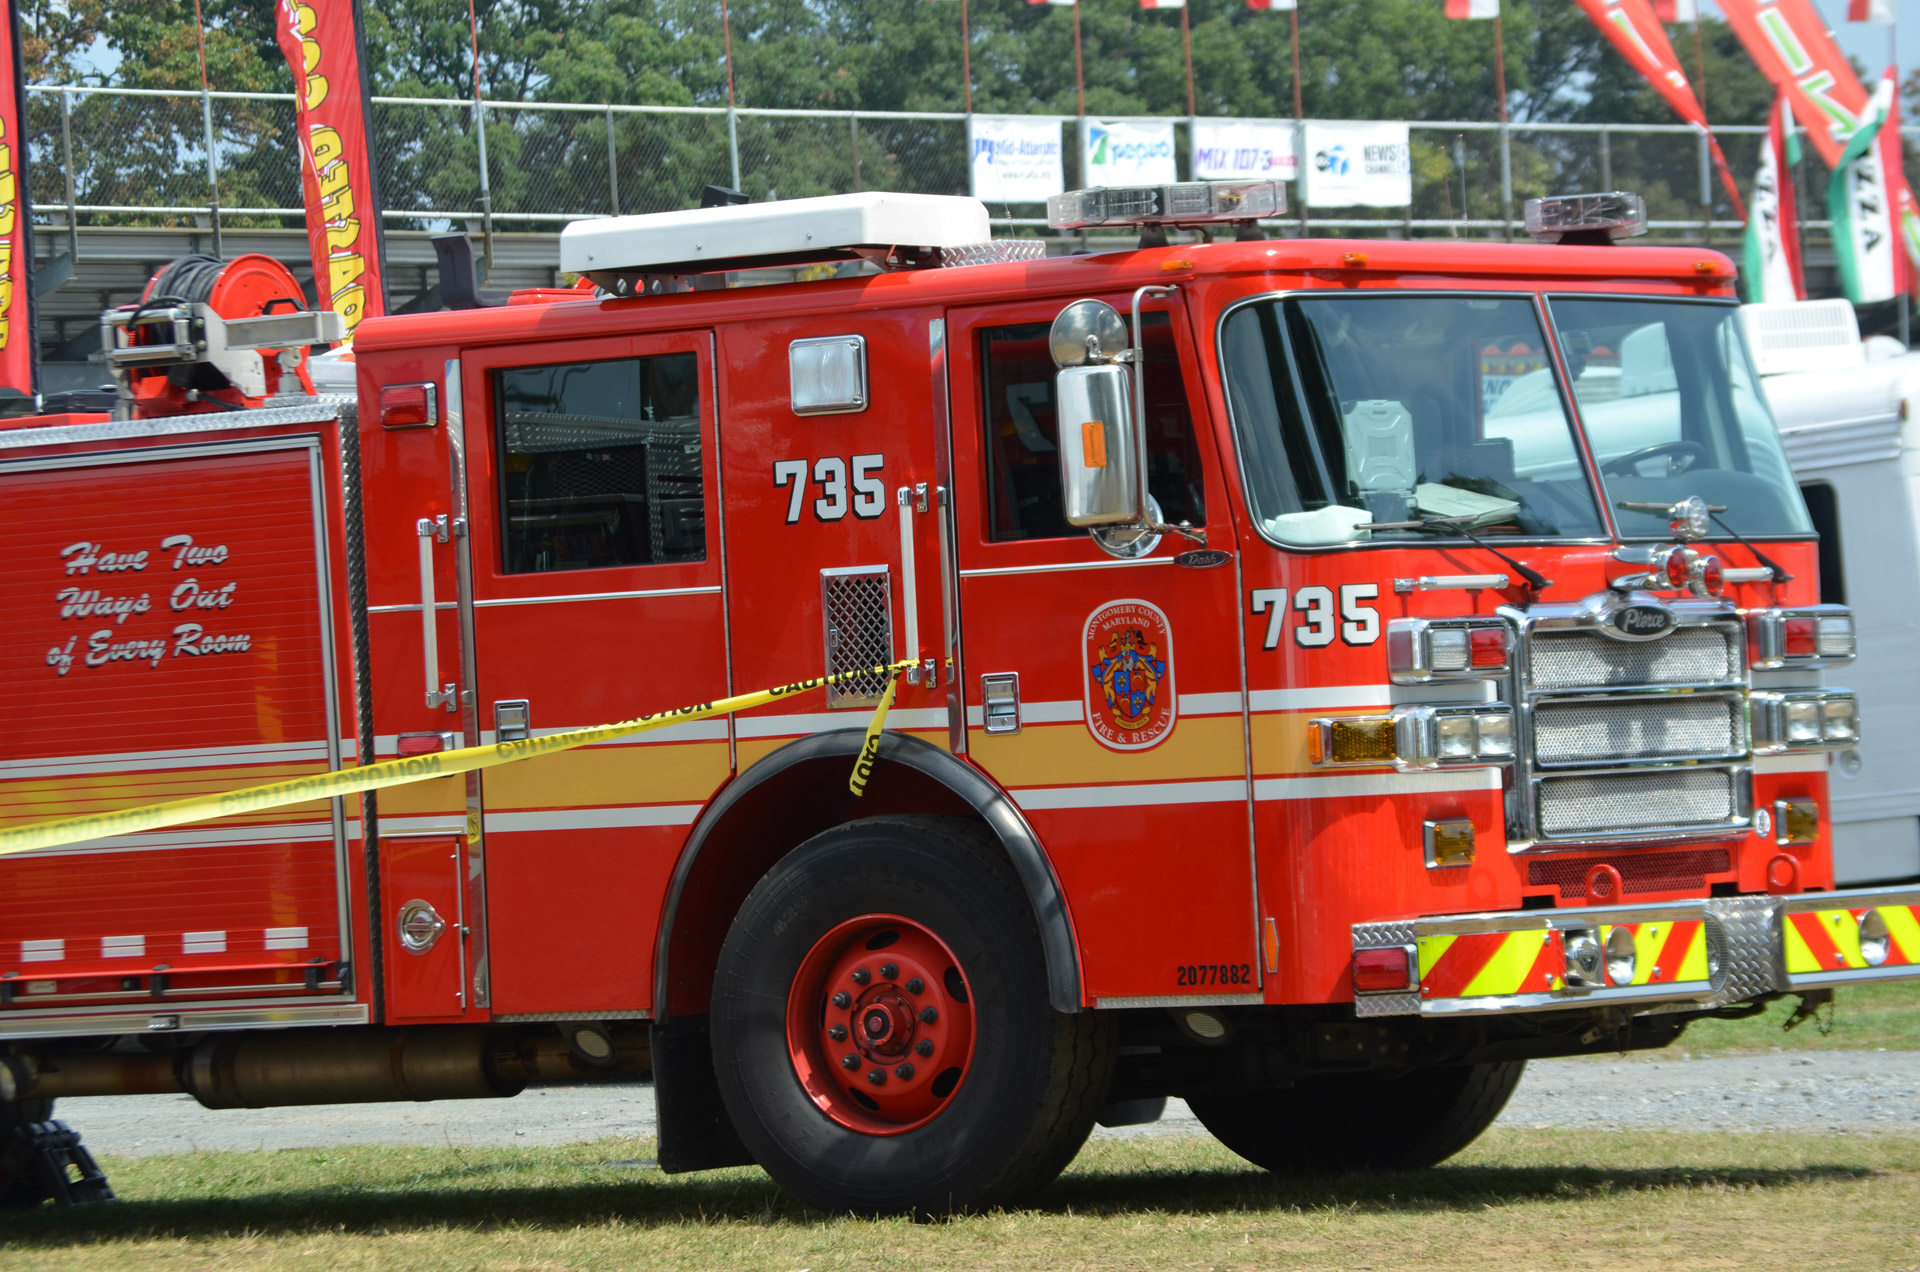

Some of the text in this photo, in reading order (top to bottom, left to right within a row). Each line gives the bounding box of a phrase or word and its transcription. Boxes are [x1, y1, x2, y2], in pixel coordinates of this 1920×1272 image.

[1112, 141, 1172, 166] pepco
[1196, 148, 1228, 170] MIX
[1363, 144, 1397, 162] NEWS
[773, 453, 886, 525] 735
[59, 534, 229, 577] Have Two
[56, 577, 238, 625] Ways Out
[1251, 583, 1381, 651] 735
[1088, 605, 1168, 641] MONTGOMERY COUNTY
[1102, 616, 1151, 632] MARYLAND
[1624, 609, 1665, 633] Pierce
[46, 623, 253, 677] of Every Room
[1092, 711, 1115, 741] FIRE
[1117, 732, 1128, 744] &
[1132, 707, 1172, 744] RESCUE
[1176, 963, 1251, 986] 2077882
